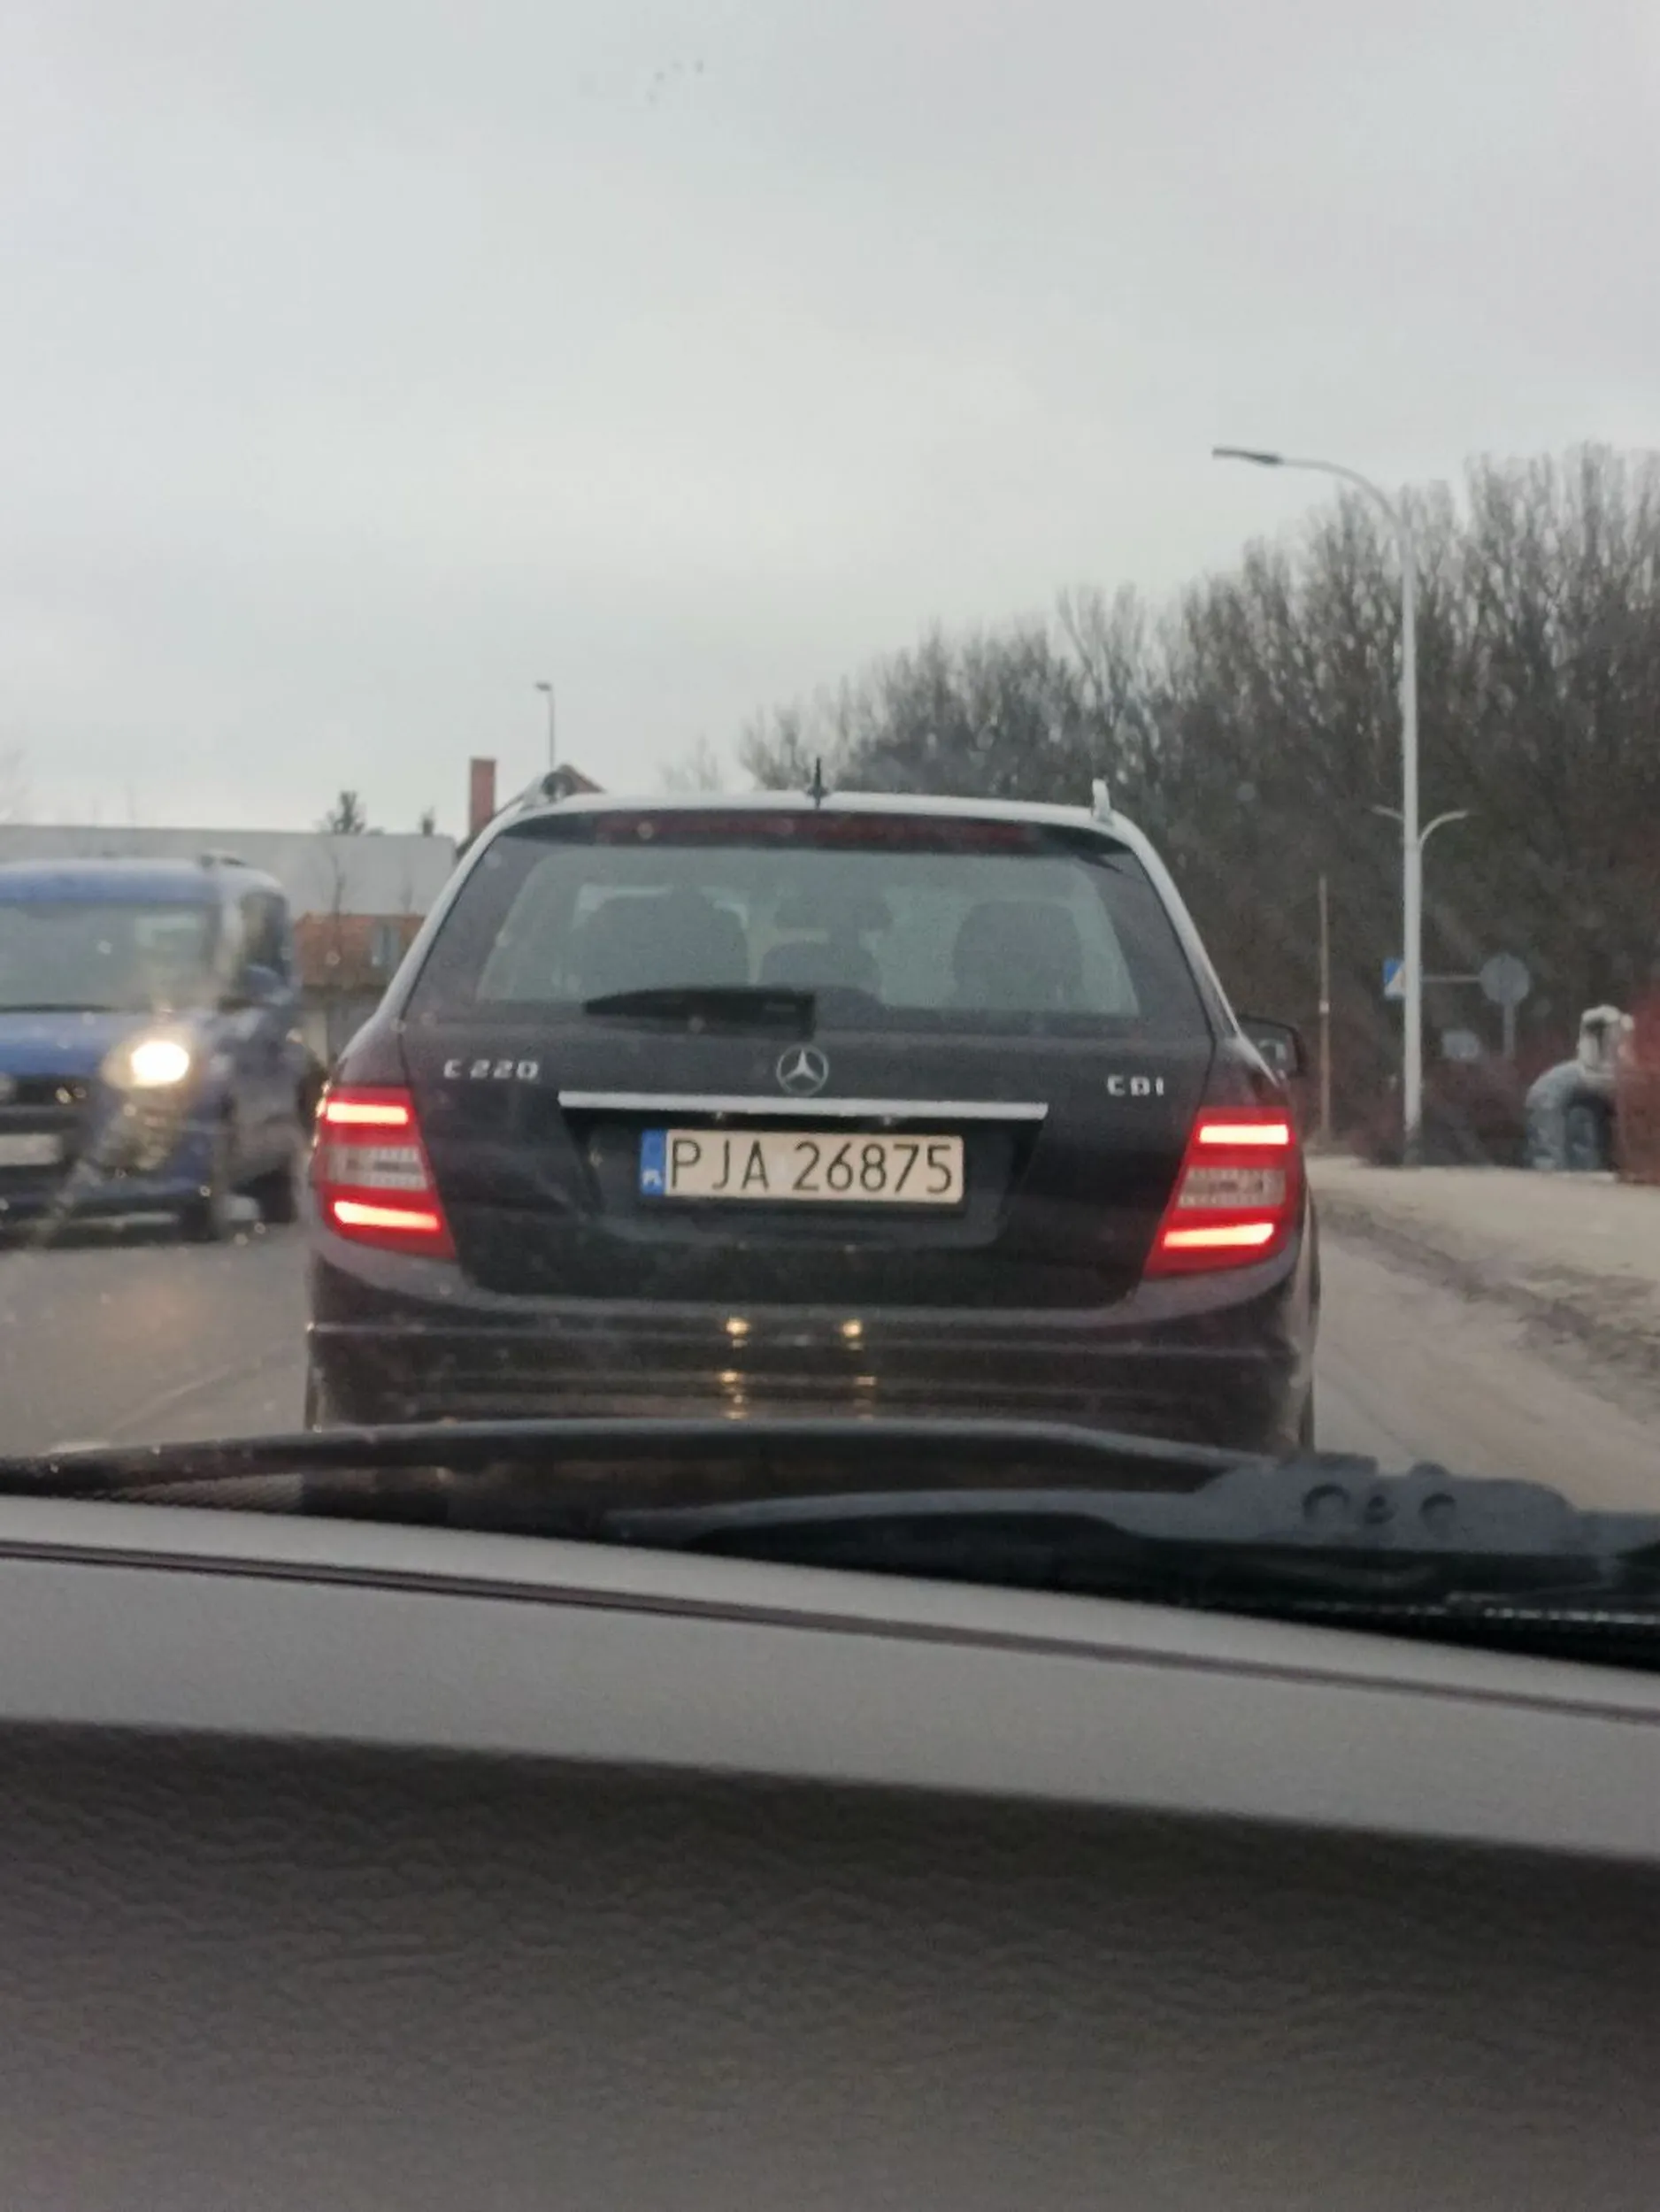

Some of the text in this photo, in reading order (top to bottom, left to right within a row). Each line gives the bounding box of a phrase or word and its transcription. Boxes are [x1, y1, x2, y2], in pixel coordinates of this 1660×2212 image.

[443, 1059, 539, 1080] C 220
[1107, 1074, 1164, 1096] CDI
[671, 1138, 953, 1194] PJA 26875
